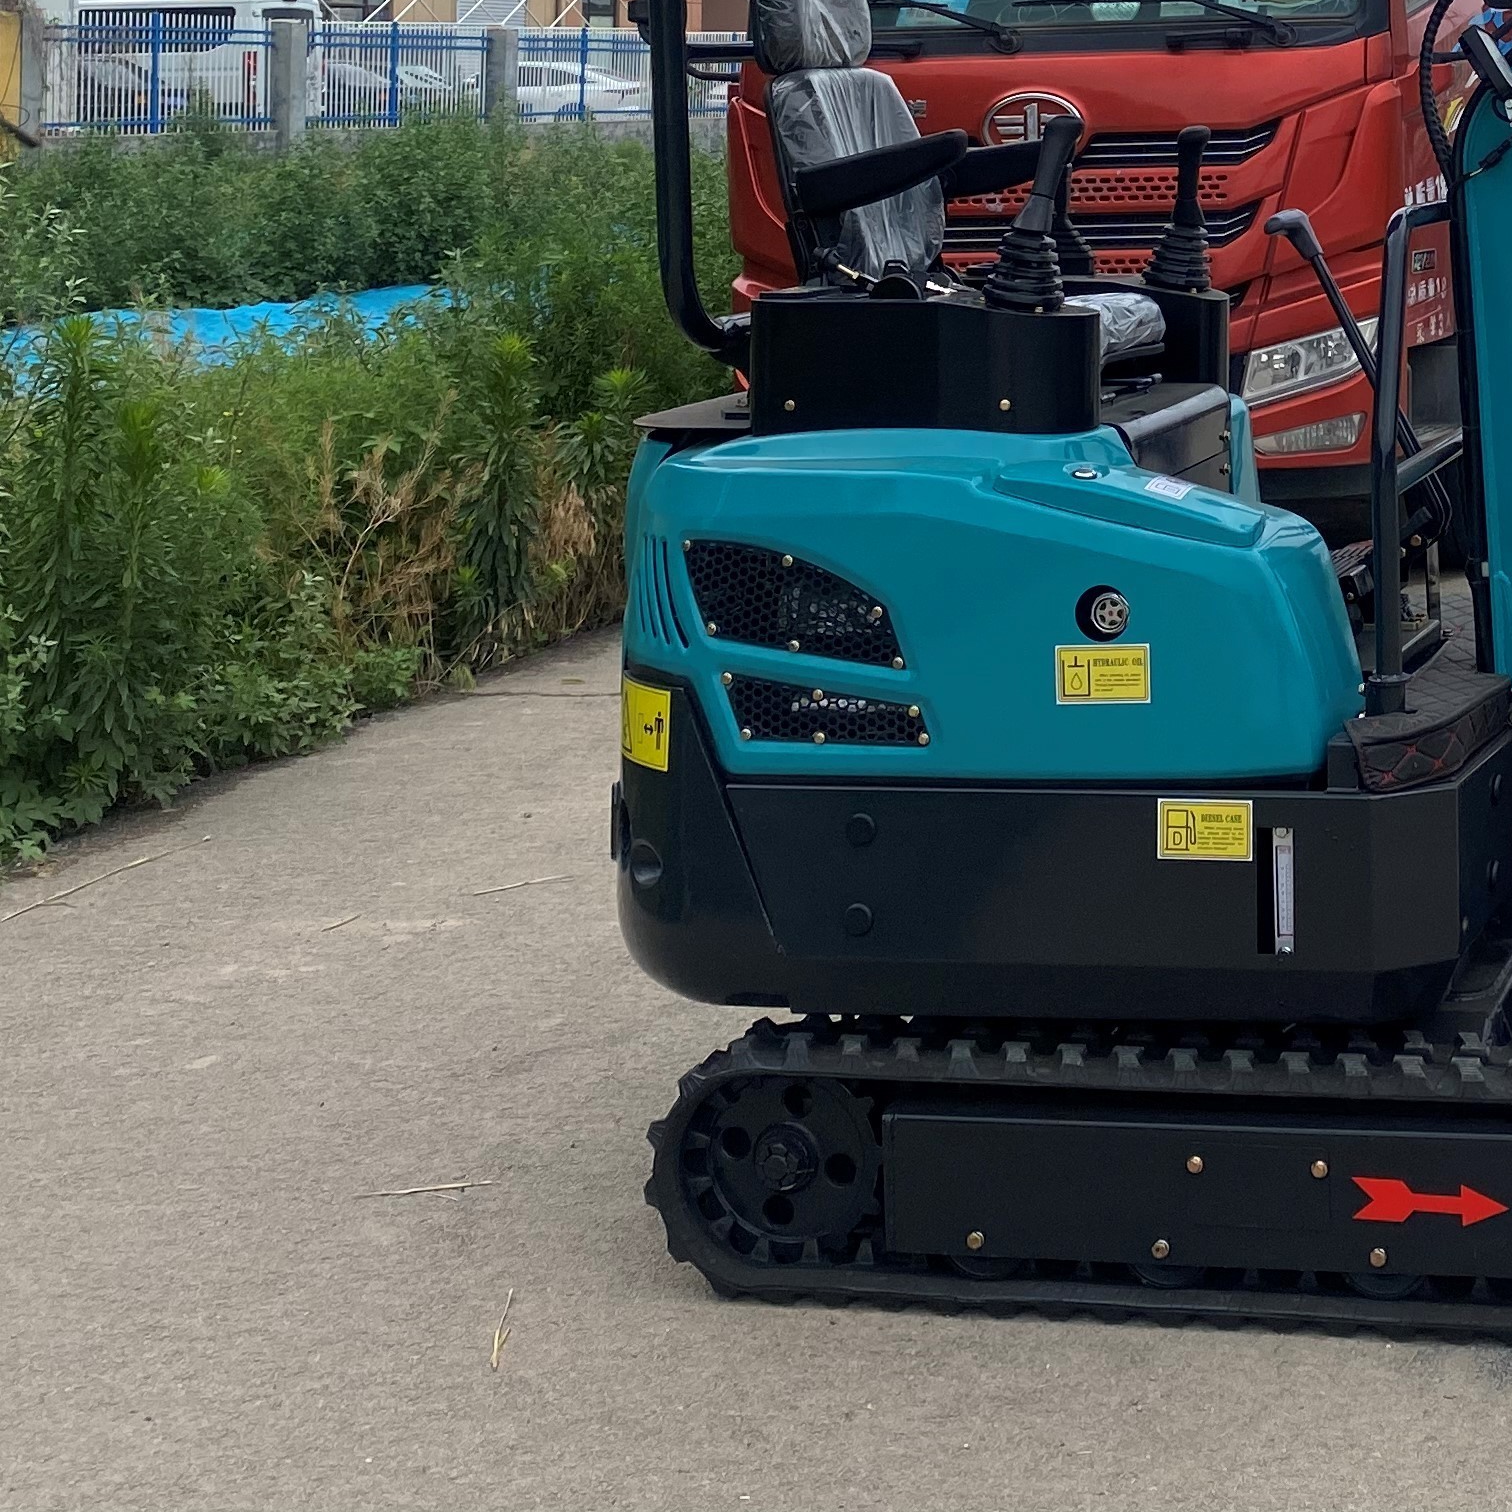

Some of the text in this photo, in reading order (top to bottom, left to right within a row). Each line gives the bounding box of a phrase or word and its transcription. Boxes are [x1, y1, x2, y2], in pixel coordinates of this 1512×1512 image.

[1092, 657, 1144, 667] HYDRAULIC OIL
[1200, 813, 1243, 824] DIESEL CASE
[1172, 831, 1183, 846] D
